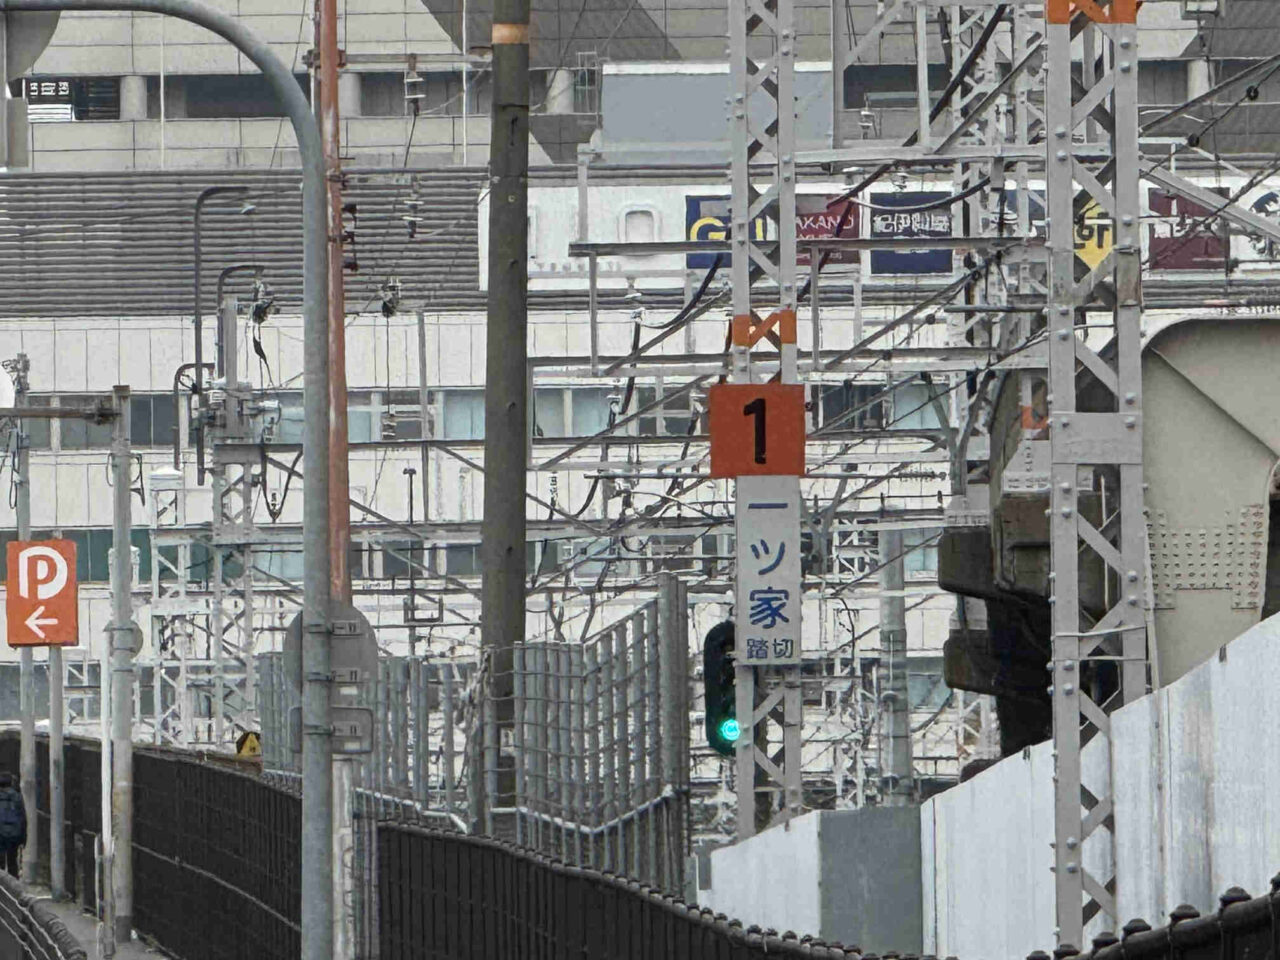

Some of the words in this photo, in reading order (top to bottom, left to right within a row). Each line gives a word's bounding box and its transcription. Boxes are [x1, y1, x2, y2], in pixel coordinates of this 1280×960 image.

[743, 398, 766, 464] 1
[18, 546, 68, 600] P
[748, 502, 790, 629] 一ツ家
[746, 638, 794, 660] 踏切
